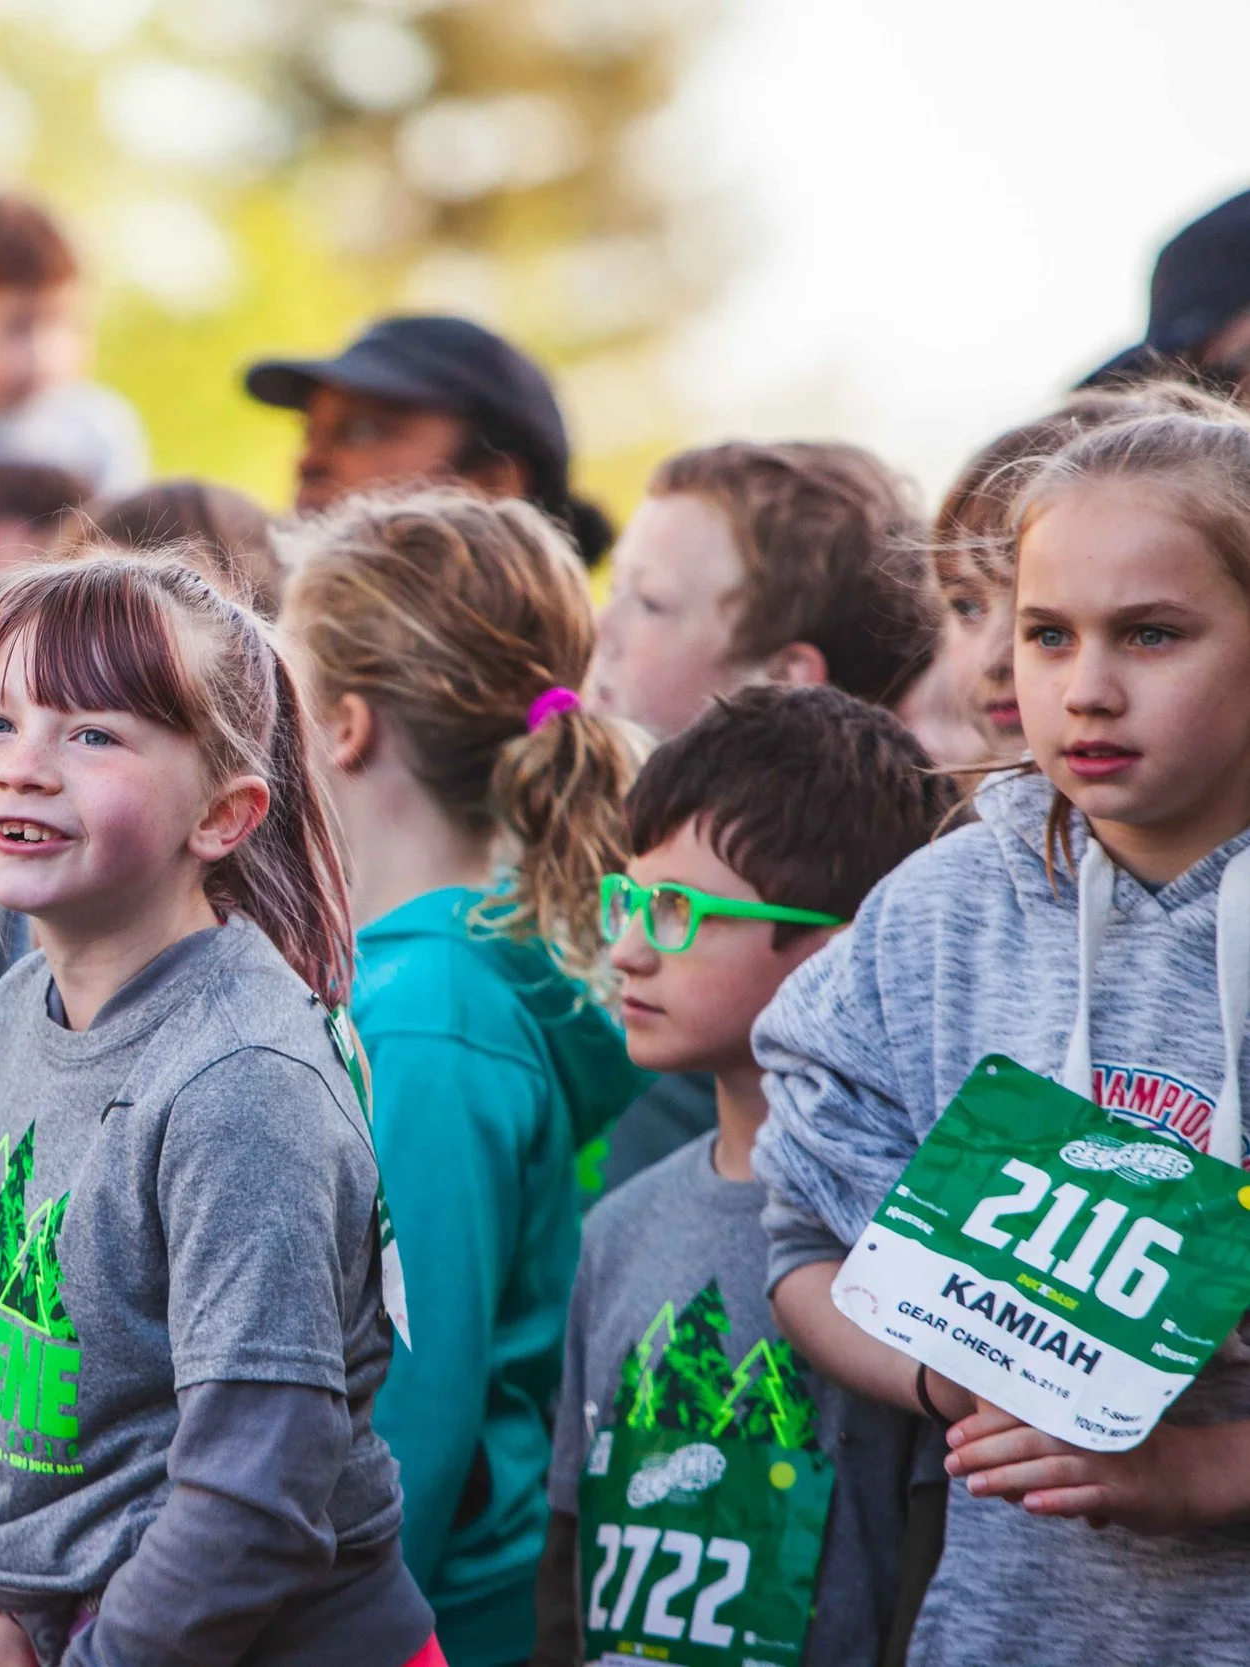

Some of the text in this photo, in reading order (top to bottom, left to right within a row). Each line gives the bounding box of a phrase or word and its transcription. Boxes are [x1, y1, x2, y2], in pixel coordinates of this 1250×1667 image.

[961, 1158, 1184, 1319] 2116
[897, 1301, 948, 1332] GEAR
[952, 1326, 1015, 1372] CHECK
[941, 1273, 1103, 1375] KAMIAH
[588, 1523, 750, 1648] 2722
